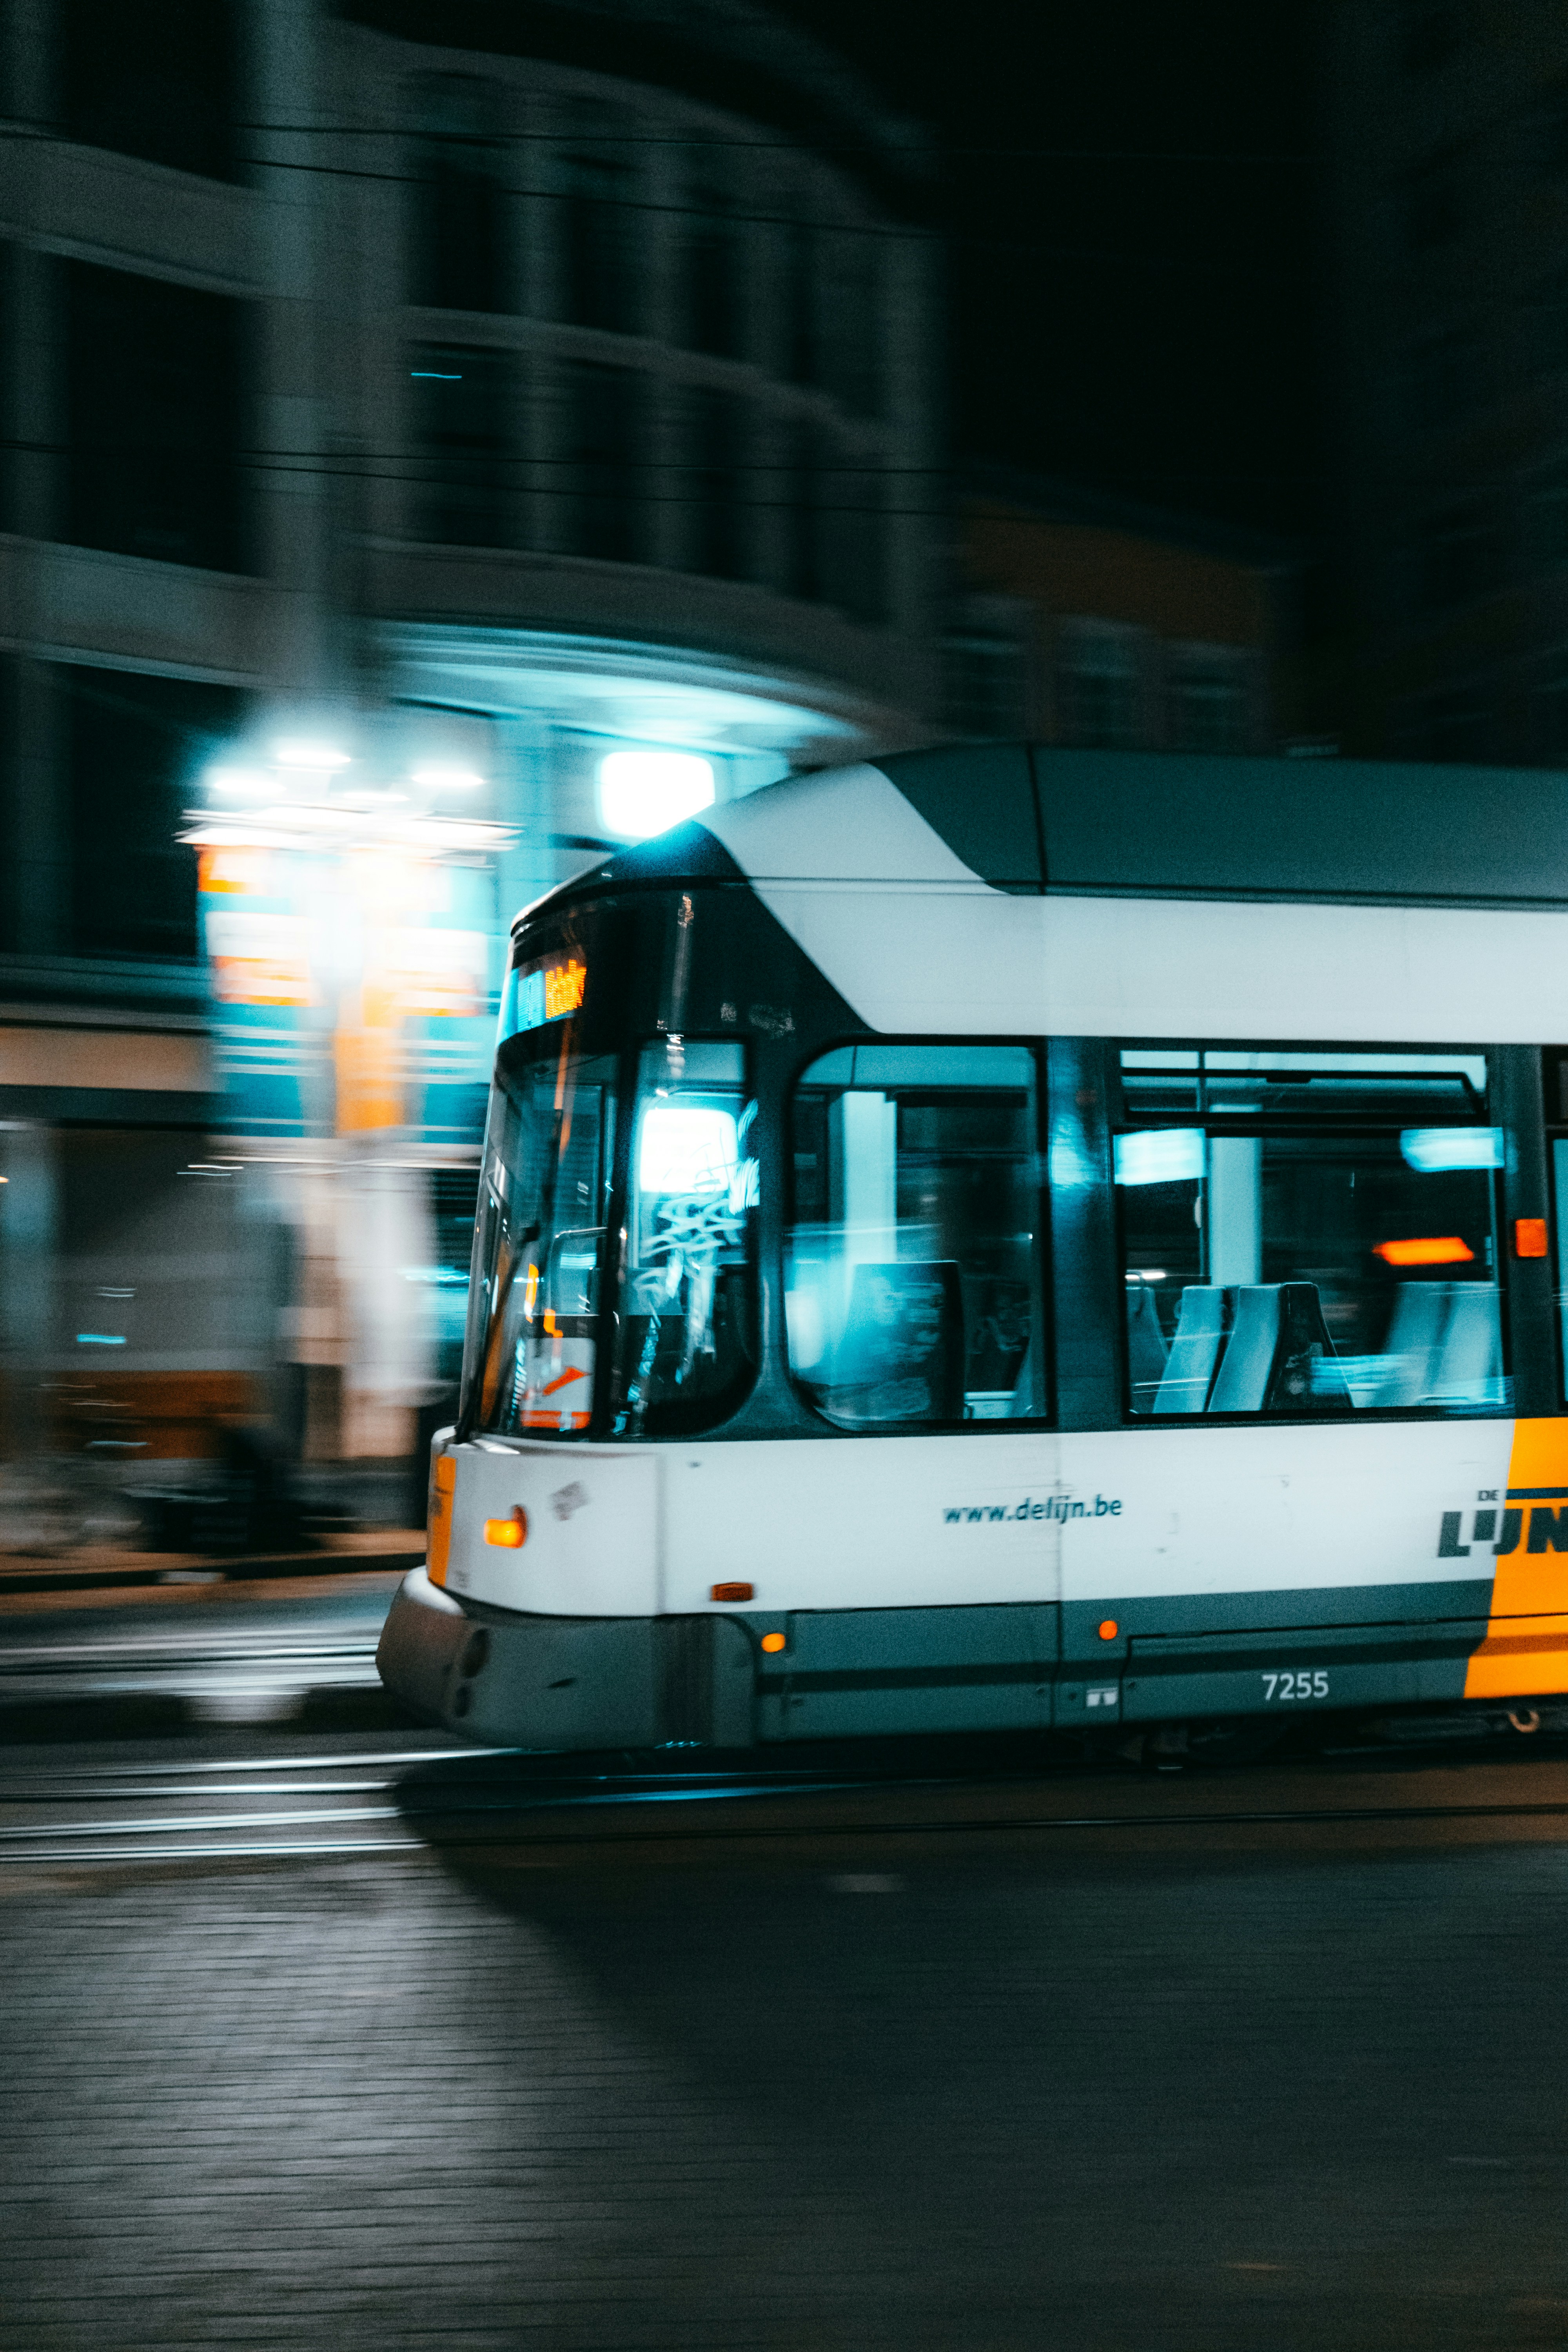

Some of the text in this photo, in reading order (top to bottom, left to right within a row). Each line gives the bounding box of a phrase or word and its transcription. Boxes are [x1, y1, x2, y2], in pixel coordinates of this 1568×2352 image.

[943, 1494, 1123, 1524] www.delijn.be
[1477, 1490, 1499, 1501] DE
[1262, 1671, 1329, 1700] 7255
